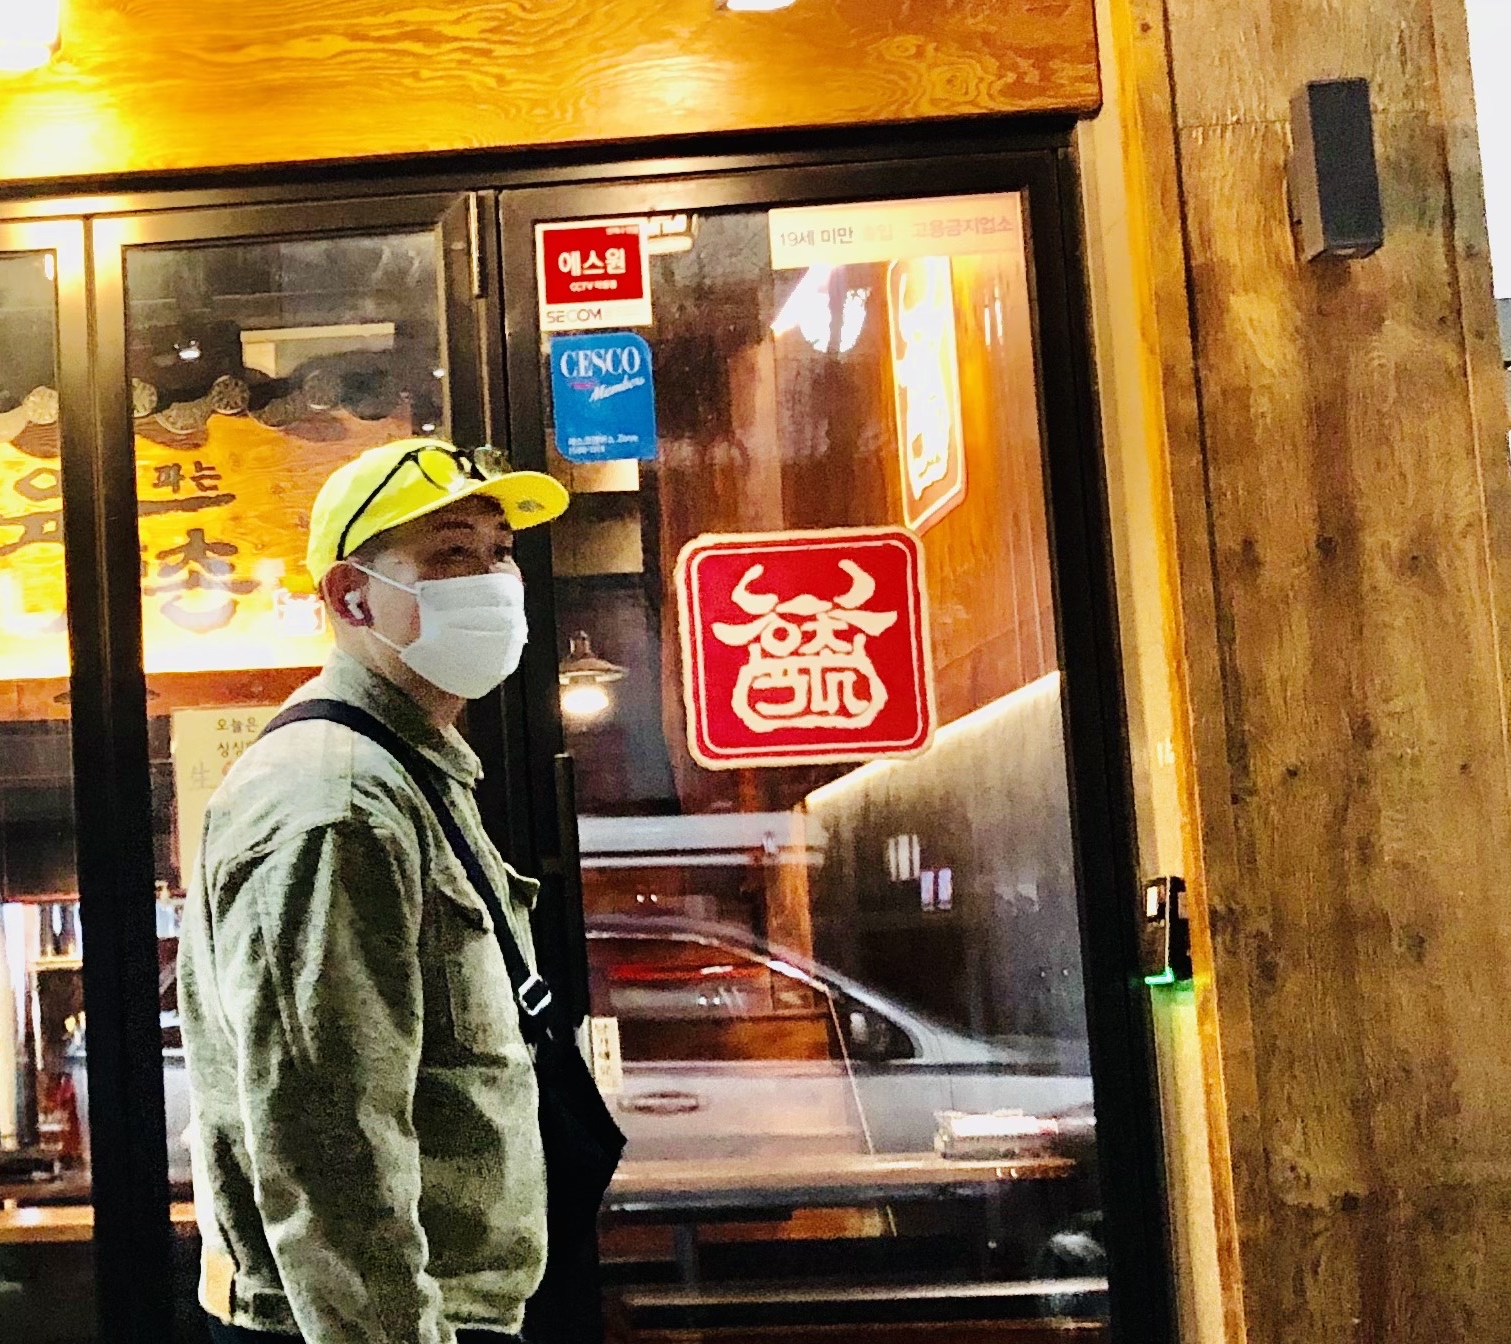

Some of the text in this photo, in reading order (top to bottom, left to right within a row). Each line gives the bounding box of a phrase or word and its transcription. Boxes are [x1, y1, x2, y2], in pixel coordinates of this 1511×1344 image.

[820, 227, 853, 245] 미만
[558, 247, 626, 276] 에스원
[546, 308, 603, 324] SECOM
[560, 346, 641, 378] CESCO
[153, 460, 222, 494] 파는
[217, 717, 259, 733] 오늘은
[217, 741, 256, 758] 싱싱
